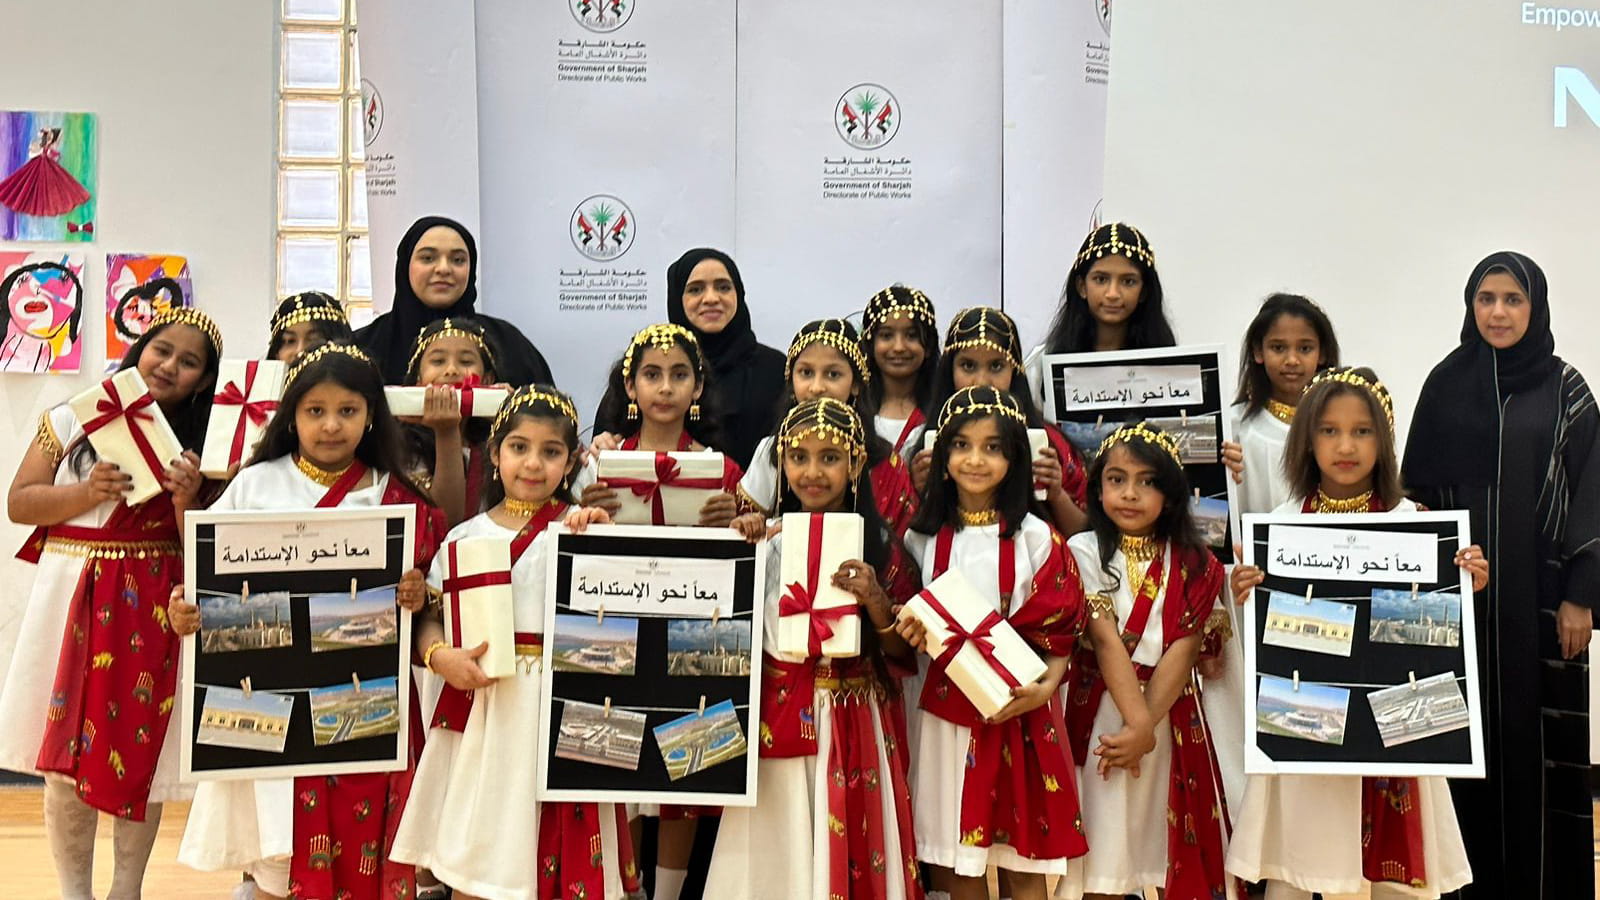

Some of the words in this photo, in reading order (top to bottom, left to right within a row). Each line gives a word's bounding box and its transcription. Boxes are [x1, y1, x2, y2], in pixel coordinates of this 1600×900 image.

[558, 64, 605, 72] Government
[617, 65, 647, 74] Sharjah
[823, 181, 870, 189] Government
[872, 181, 880, 189] of
[882, 182, 912, 191] Sharjah
[618, 293, 647, 302] Sharjah
[1141, 386, 1163, 404] نحو
[306, 543, 338, 563] نحو
[1357, 557, 1389, 575] نحو
[657, 584, 687, 603] نحو
